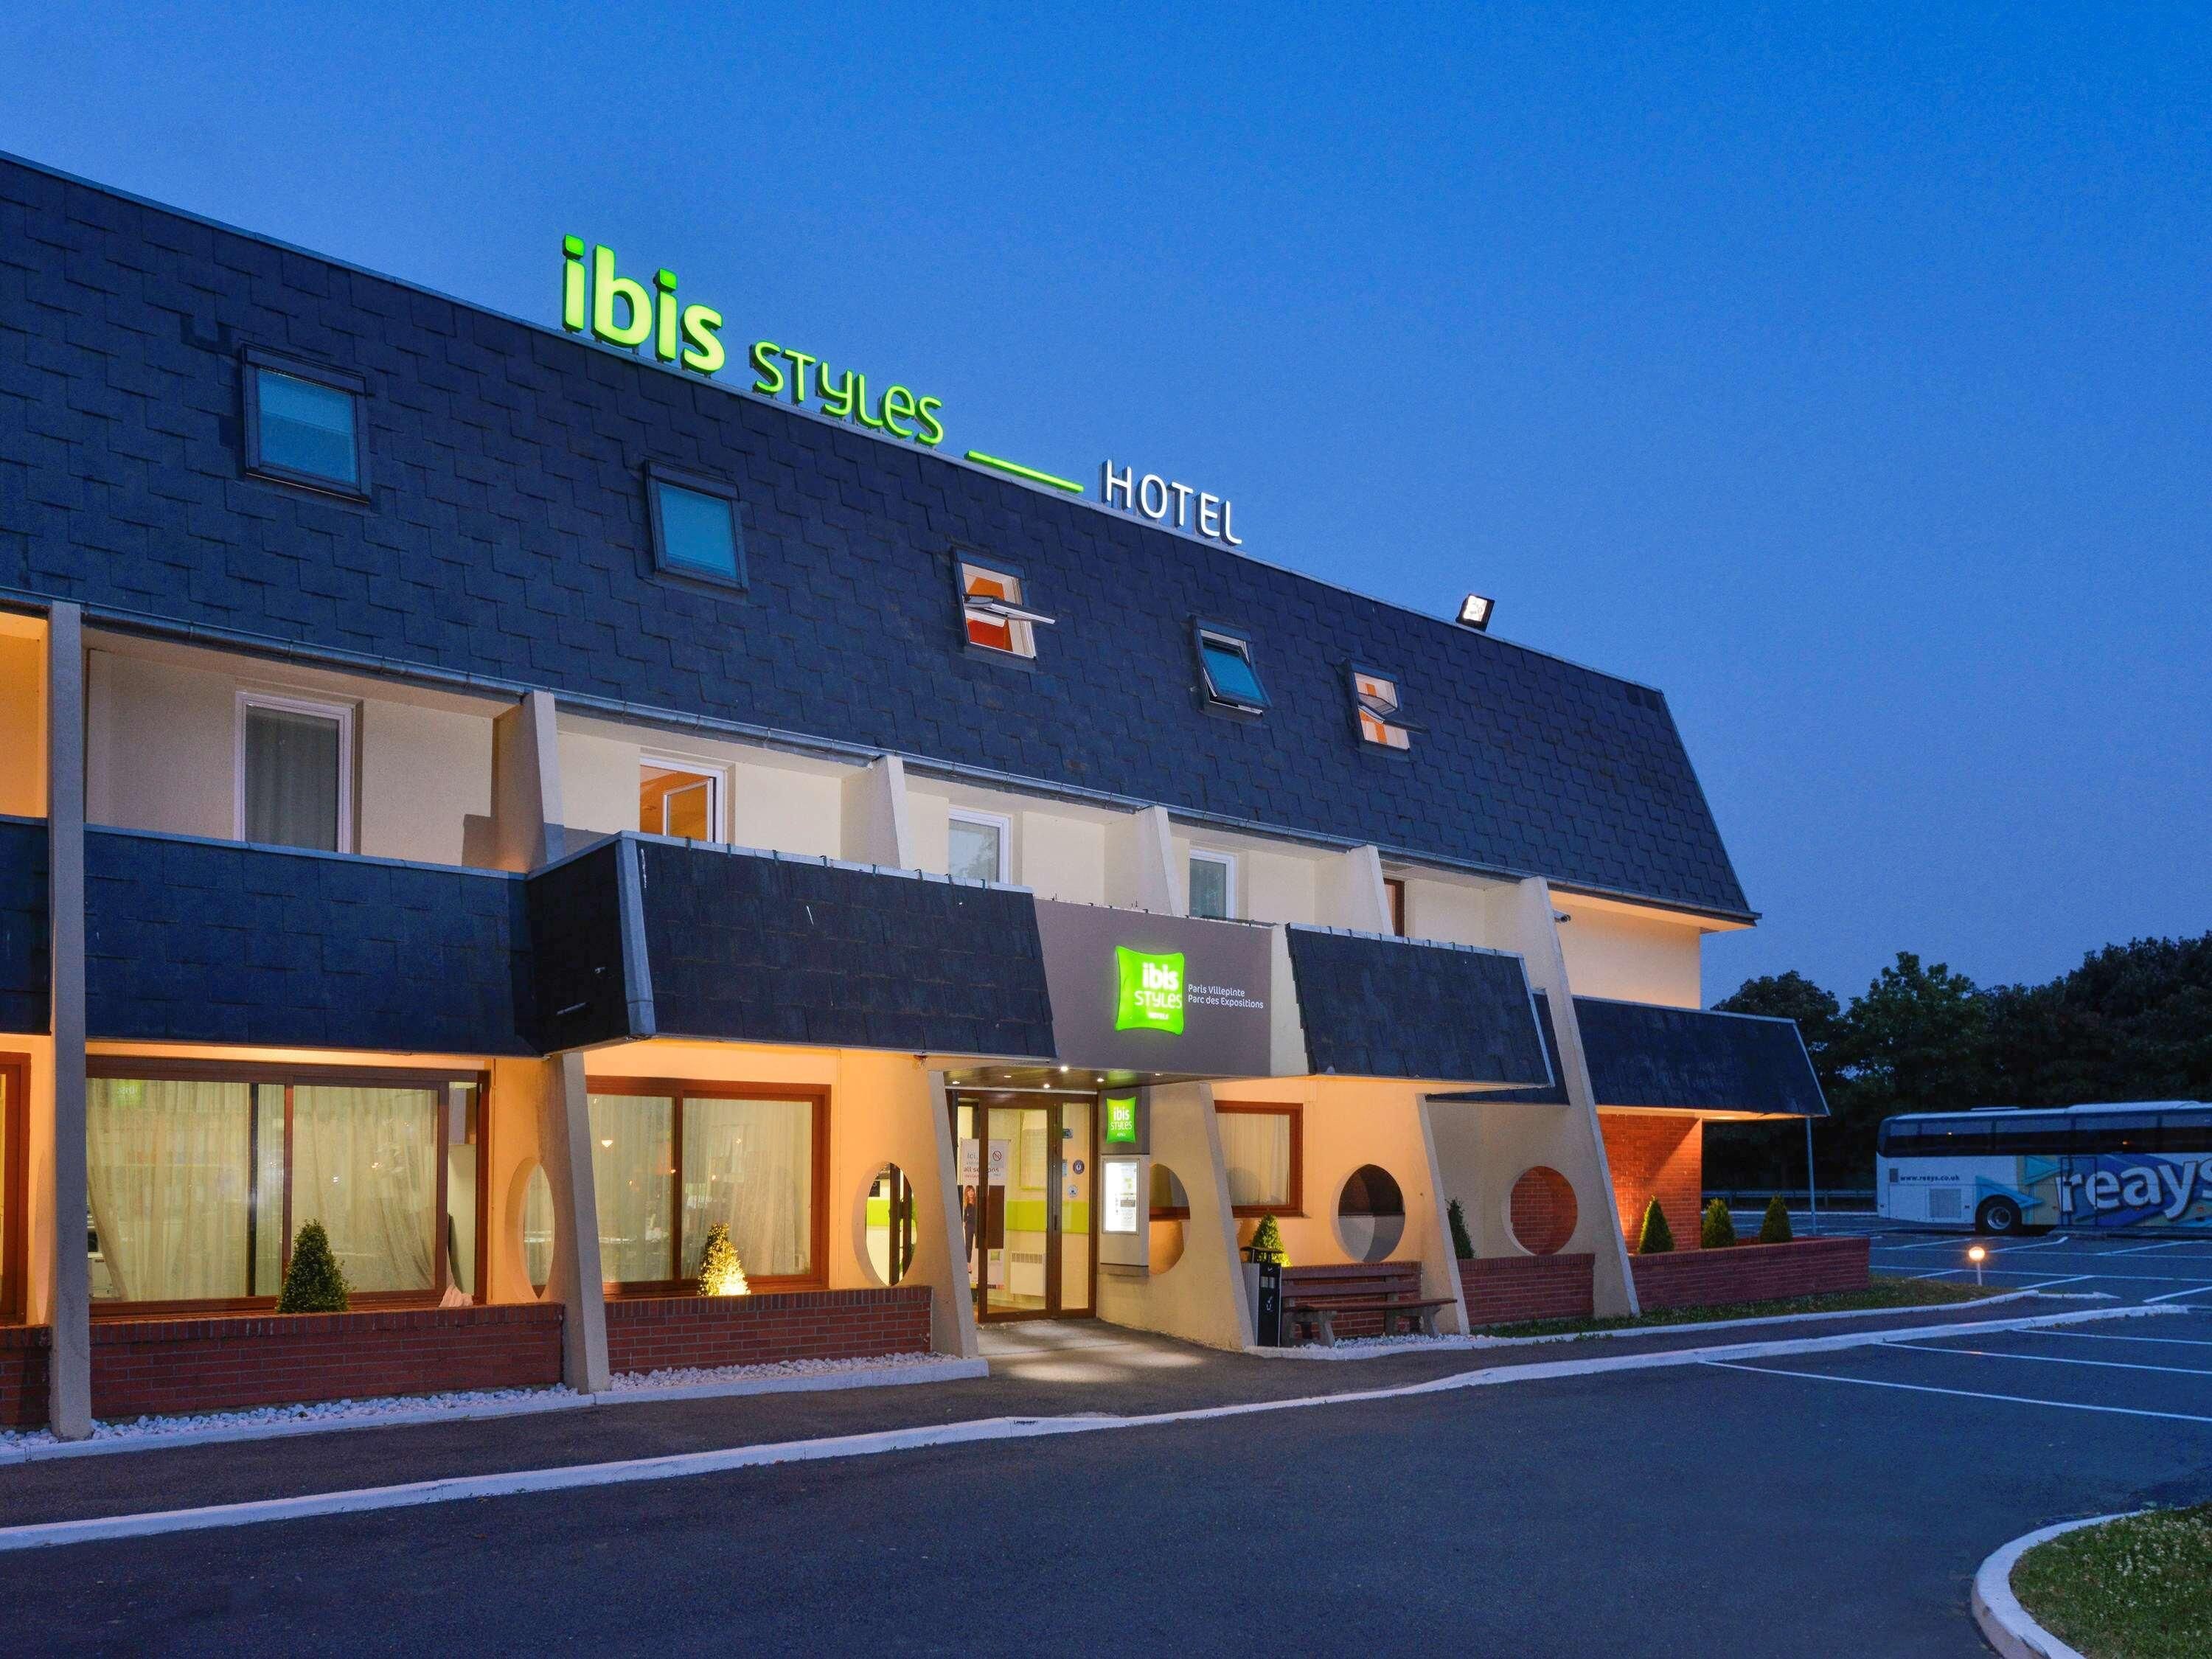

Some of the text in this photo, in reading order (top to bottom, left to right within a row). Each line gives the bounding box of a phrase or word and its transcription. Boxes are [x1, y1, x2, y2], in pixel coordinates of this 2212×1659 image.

[563, 234, 726, 374] ibis
[1102, 459, 1242, 546] HOTEL
[1142, 961, 1179, 991] ibis
[1188, 984, 1245, 997] Paris Villepinte
[1188, 995, 1264, 1009] Parc des Expositions
[1113, 1107, 1130, 1121] ibis
